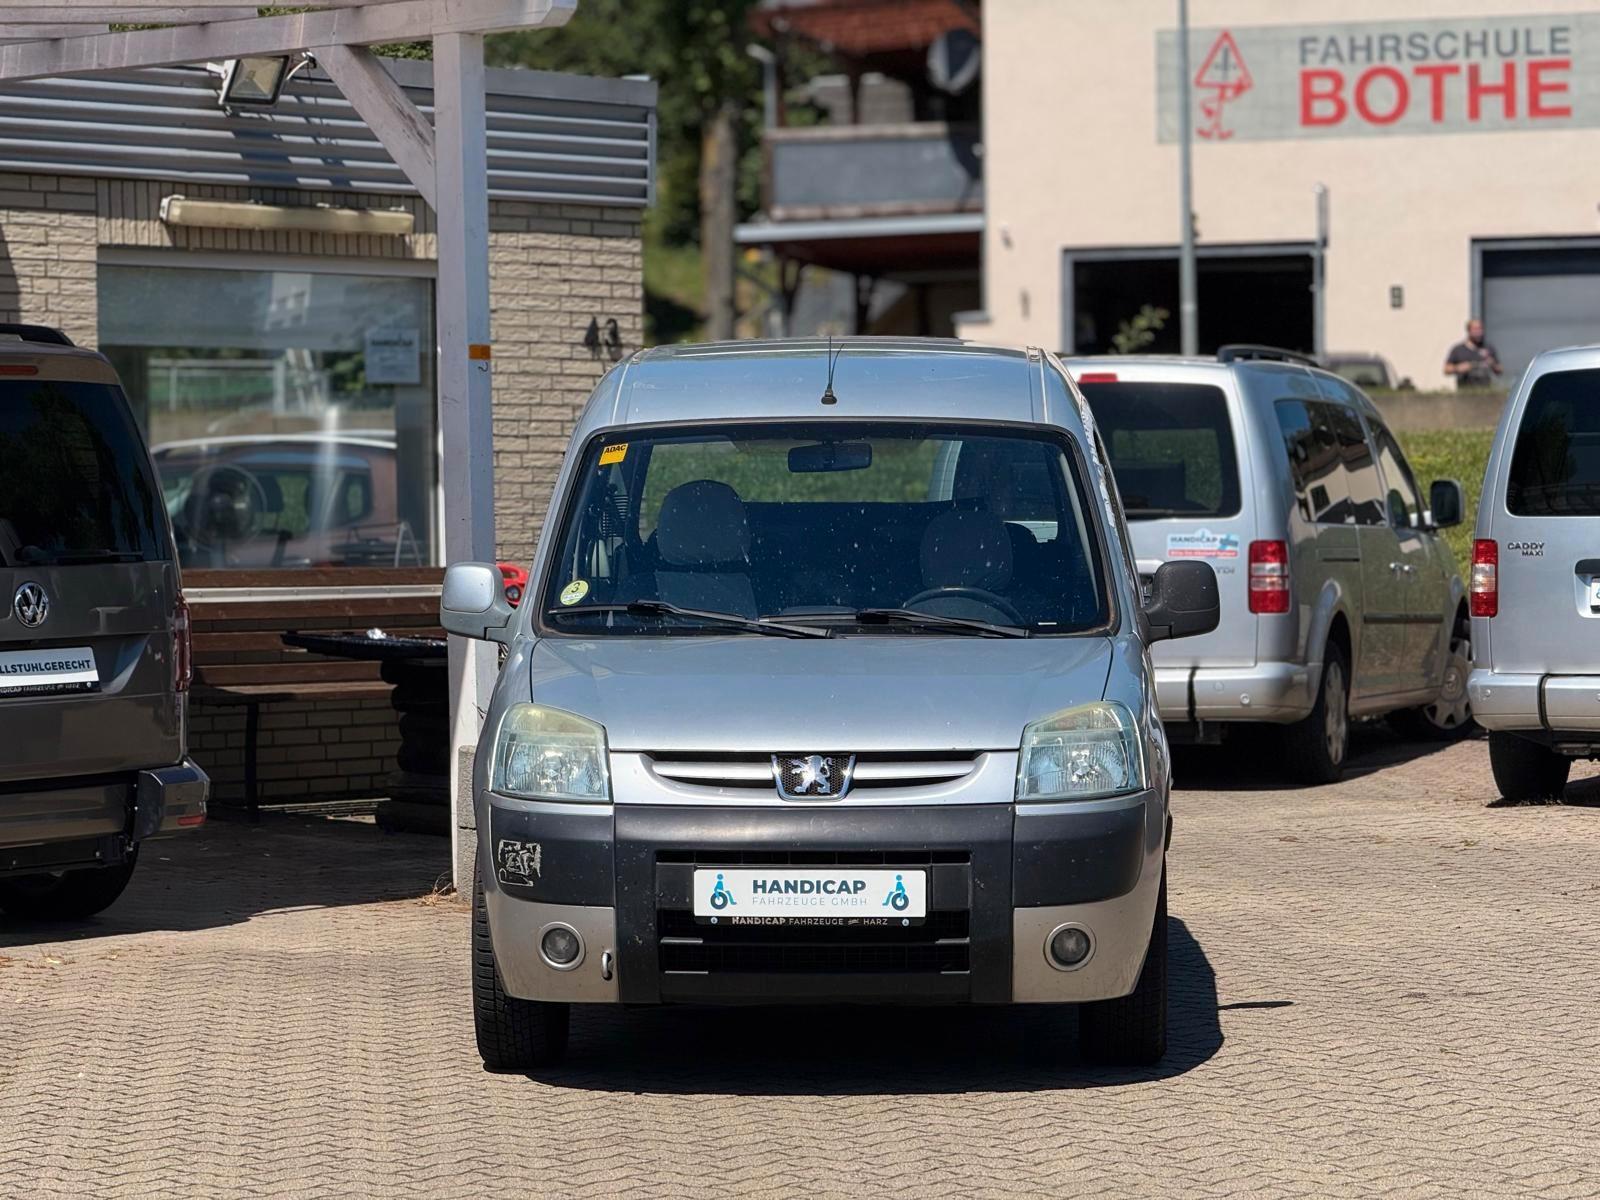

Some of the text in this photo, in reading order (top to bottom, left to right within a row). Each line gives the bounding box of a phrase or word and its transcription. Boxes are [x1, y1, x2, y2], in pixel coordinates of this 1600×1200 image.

[1299, 26, 1571, 66] FAHRSCHULE
[1299, 59, 1572, 127] BOTHE
[604, 445, 627, 455] ADAC
[1507, 542, 1545, 550] CADDY
[571, 582, 581, 593] 3
[752, 879, 867, 895] HANDICAP
[752, 896, 867, 906] FAHRZEUGE GMBH
[731, 916, 888, 926] HANDICAP FAHRZEUGE HARZ
